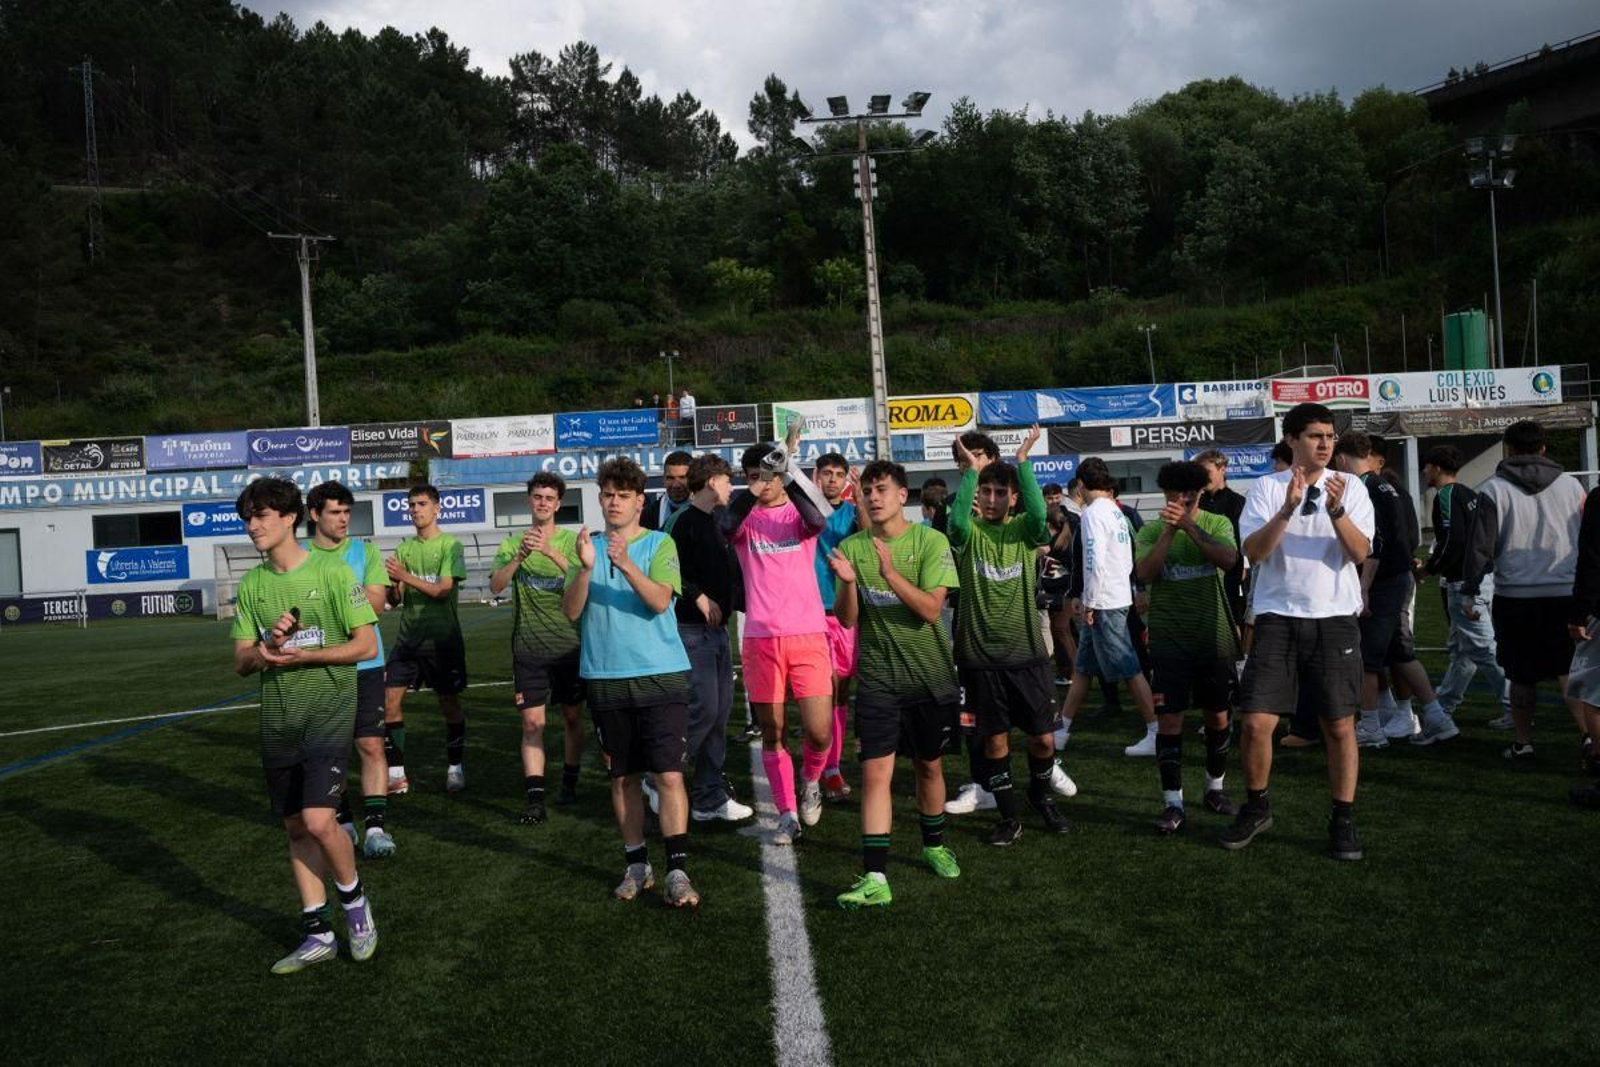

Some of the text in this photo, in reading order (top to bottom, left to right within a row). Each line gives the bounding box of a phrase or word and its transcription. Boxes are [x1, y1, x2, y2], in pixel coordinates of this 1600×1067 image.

[1437, 371, 1496, 387] COLEXIO
[1203, 382, 1269, 393] BARREIROS
[1315, 381, 1364, 397] OTERO
[1428, 385, 1506, 403] LUIS VIVES
[888, 404, 959, 423] ROMA
[786, 415, 837, 429] Rmos
[351, 427, 418, 441] Eliseo Vidal
[1134, 424, 1215, 444] PERSAN
[542, 449, 677, 477] CONLL
[1033, 460, 1073, 471] move
[74, 475, 223, 501] MUNICIPAL
[387, 498, 410, 511] OS
[403, 511, 466, 521] RRANTE
[43, 600, 87, 615] TERCE
